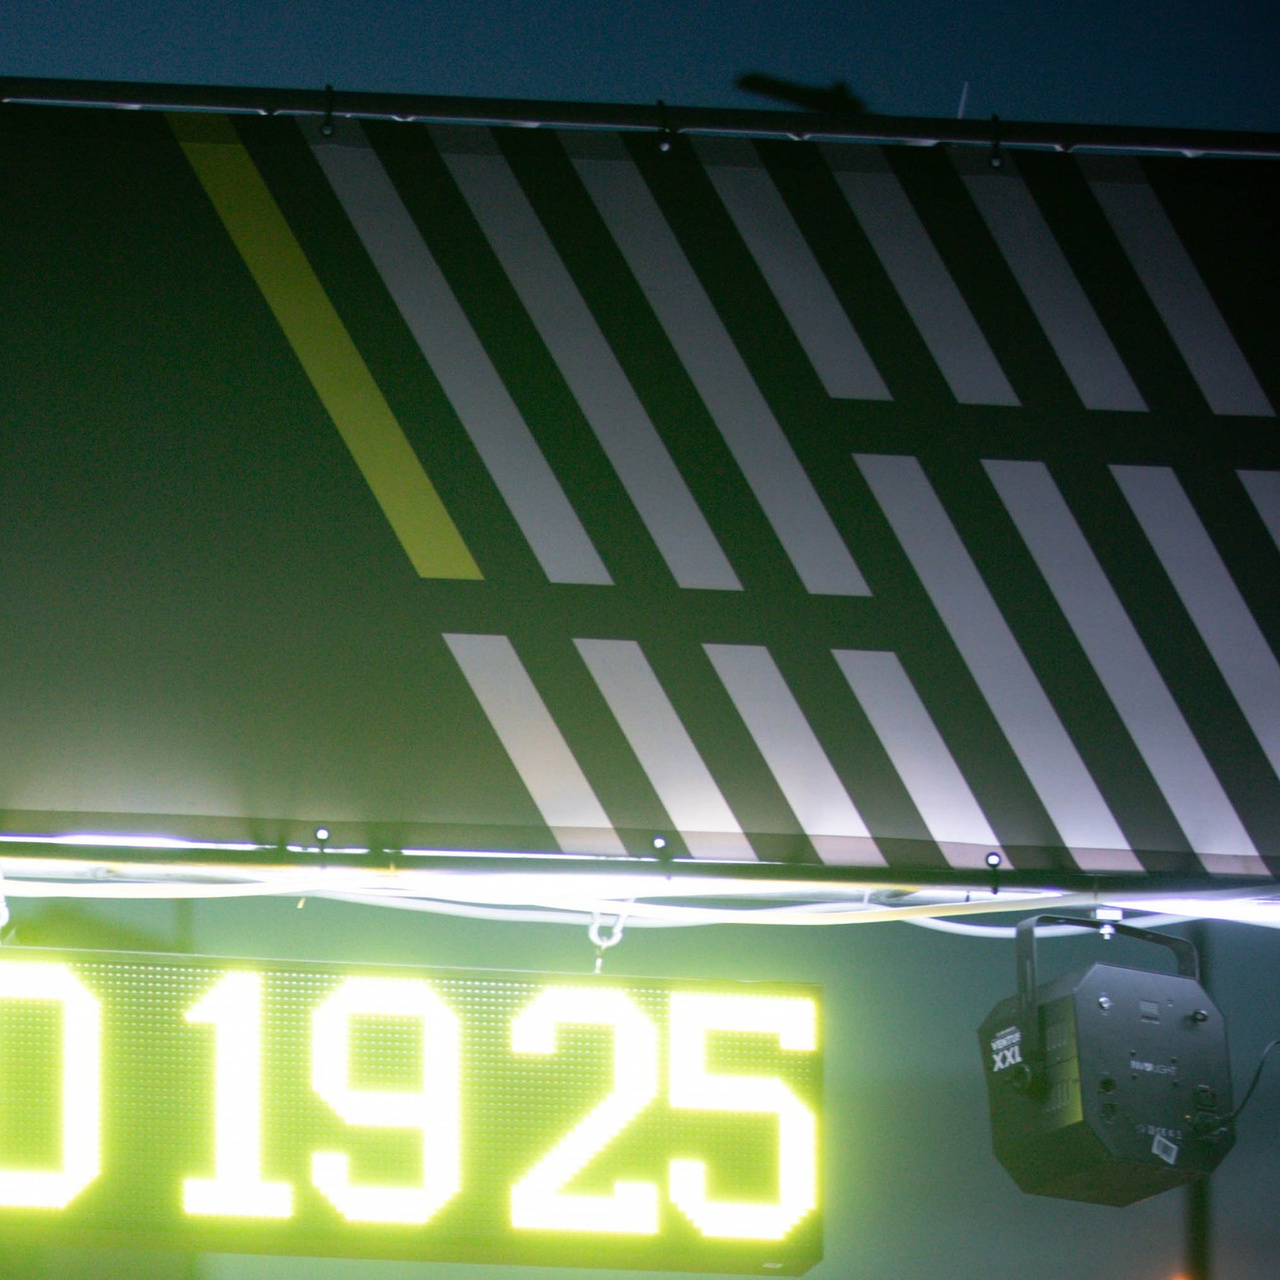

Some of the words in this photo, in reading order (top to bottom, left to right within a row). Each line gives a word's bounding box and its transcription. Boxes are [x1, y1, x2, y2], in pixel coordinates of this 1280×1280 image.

[181, 968, 464, 1226] 19
[508, 983, 819, 1241] 25
[992, 1045, 1022, 1072] XXL
